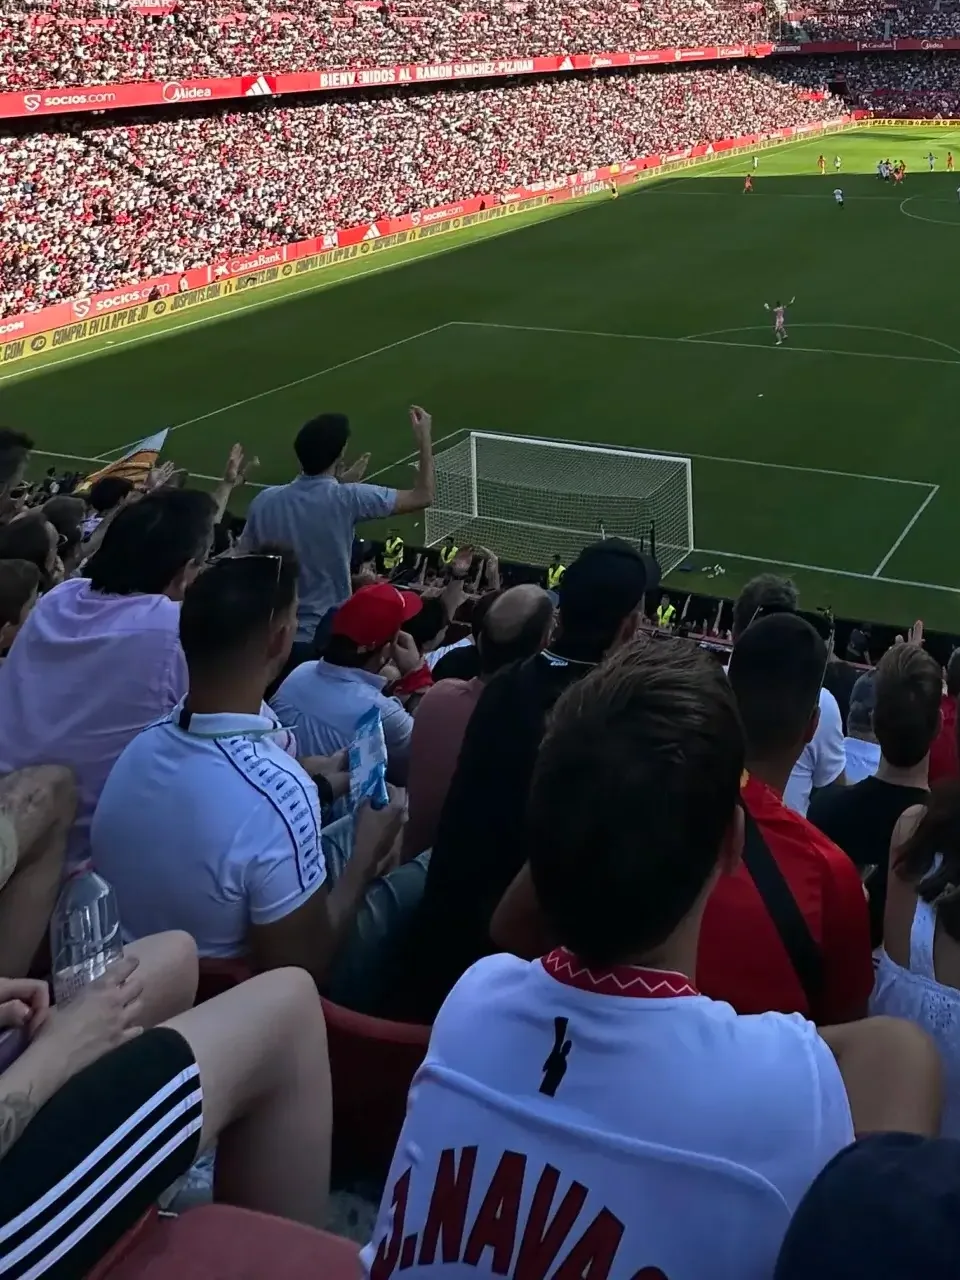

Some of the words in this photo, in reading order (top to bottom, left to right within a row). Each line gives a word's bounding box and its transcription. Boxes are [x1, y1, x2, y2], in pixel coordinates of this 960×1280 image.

[399, 69, 412, 81] AL
[167, 85, 211, 101] Midea
[231, 252, 281, 273] CaixaBank
[96, 282, 170, 311] socios.cm
[52, 322, 86, 347] COMPRA
[89, 317, 101, 335] EN
[112, 310, 127, 329] APP
